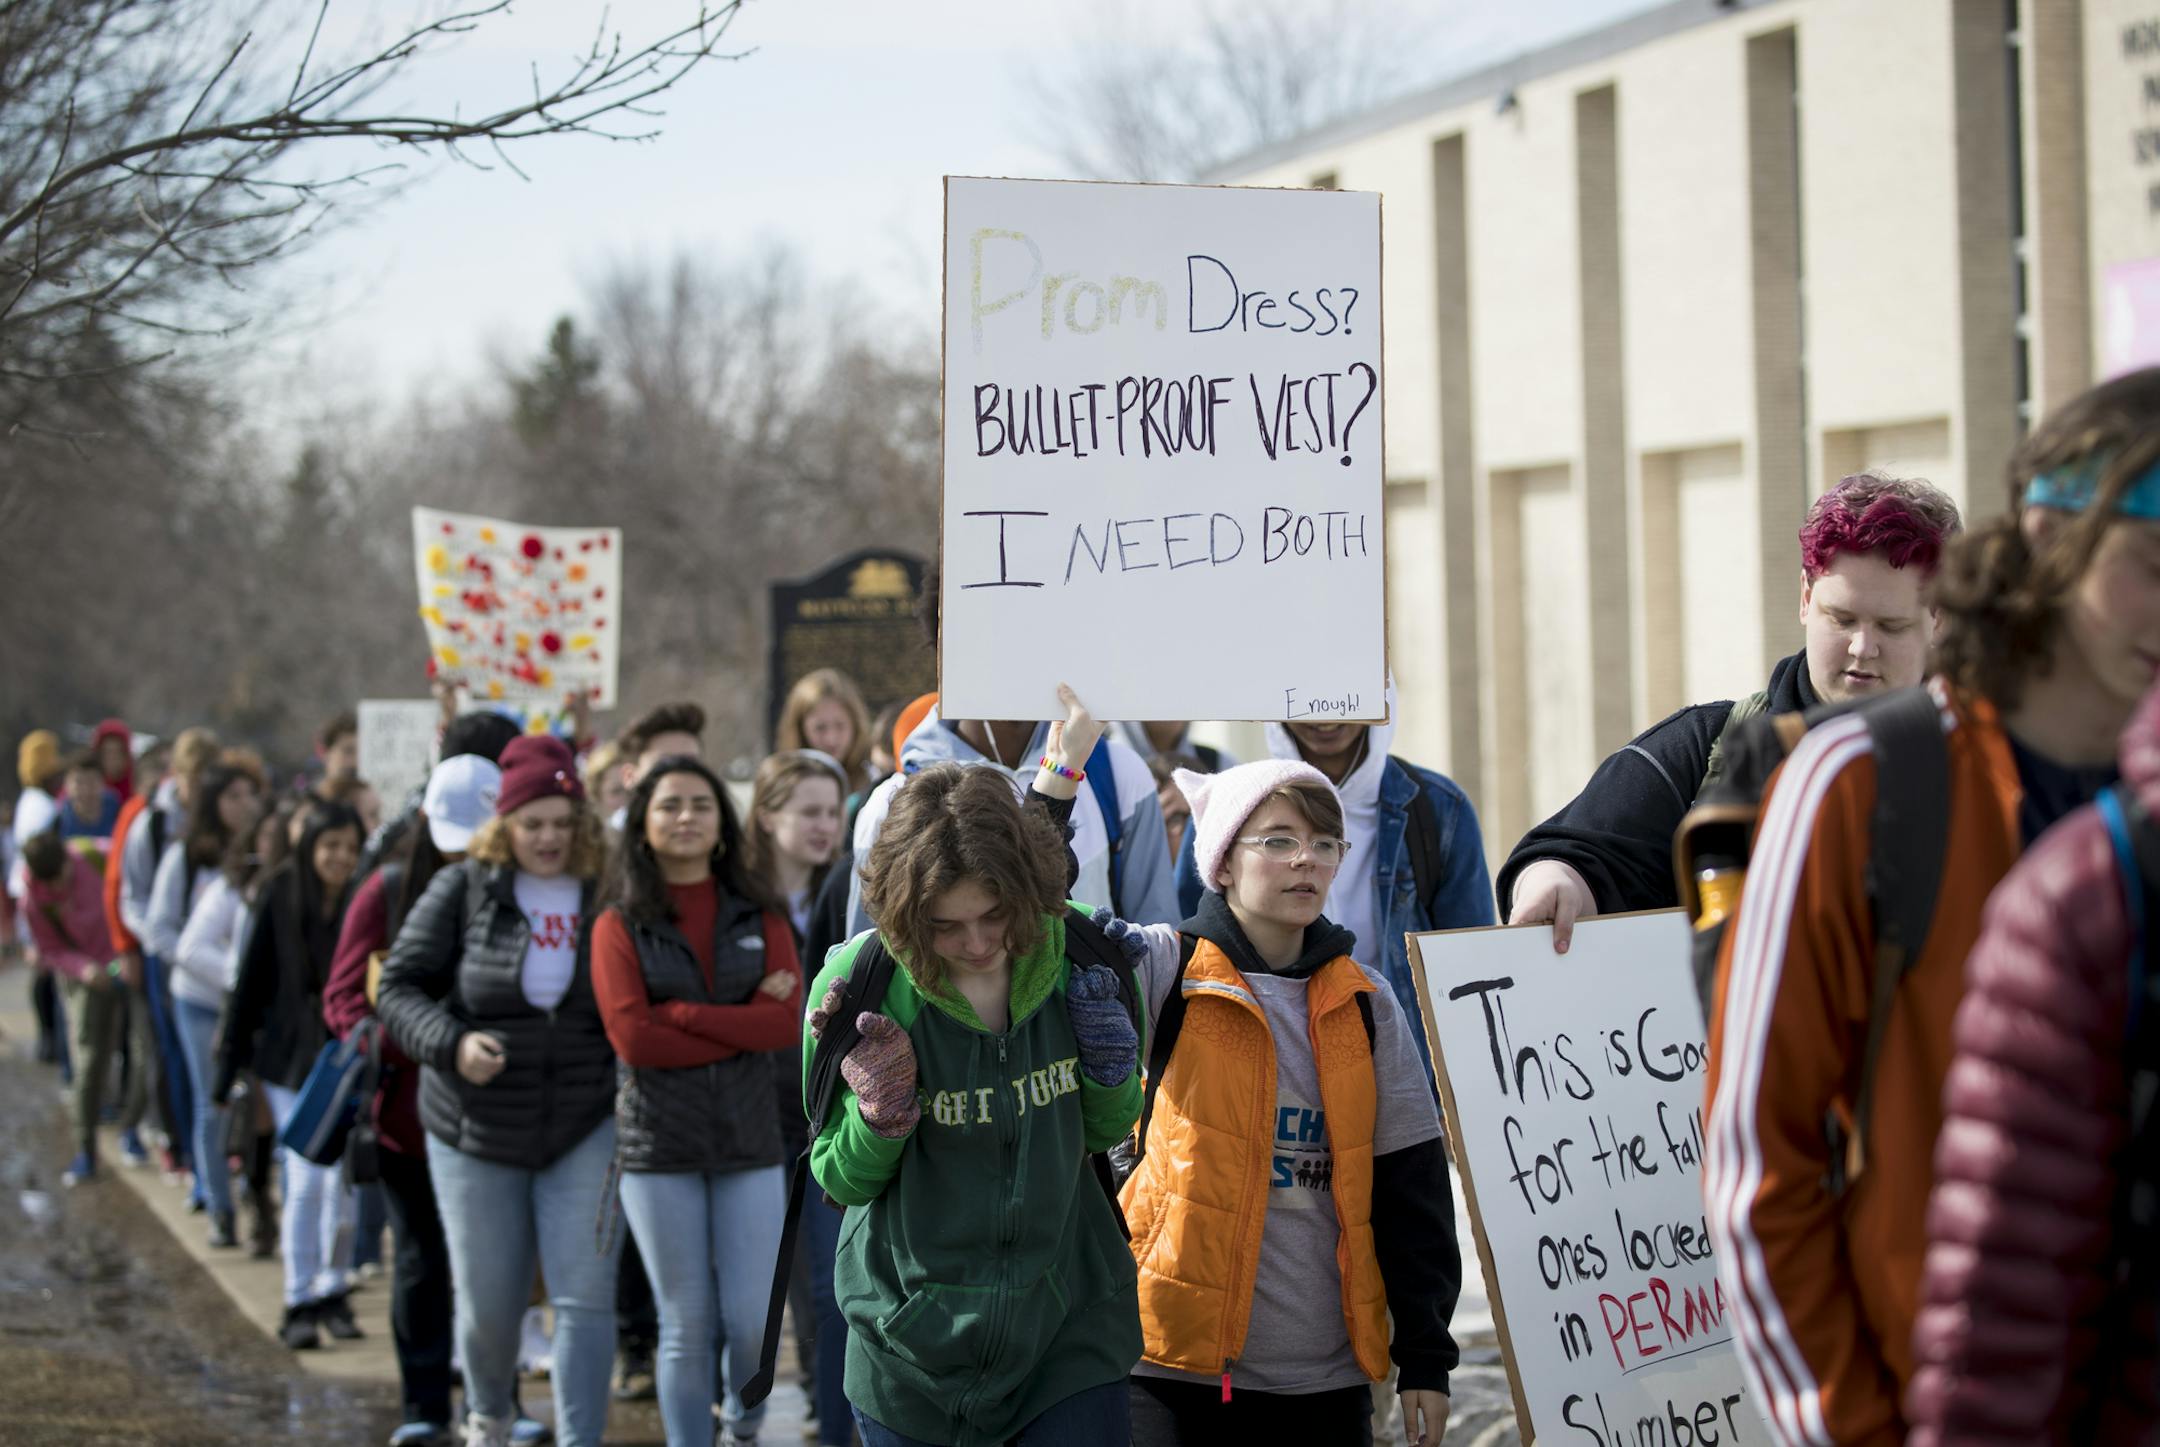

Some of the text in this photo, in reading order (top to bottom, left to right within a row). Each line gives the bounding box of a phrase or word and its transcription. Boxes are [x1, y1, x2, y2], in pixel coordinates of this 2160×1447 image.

[970, 227, 1359, 355] Prom Dress?
[973, 361, 1378, 467] BULLET-PROOF VEST?
[961, 506, 1368, 590] I NEED BOTH
[1285, 687, 1360, 719] Enough!
[1600, 1029, 1632, 1077] is
[1273, 1106, 1326, 1143] CH
[1504, 1115, 1574, 1215] for
[1591, 1114, 1659, 1190] the
[1538, 1207, 1714, 1290] ones locked
[1554, 1311, 1593, 1363] in
